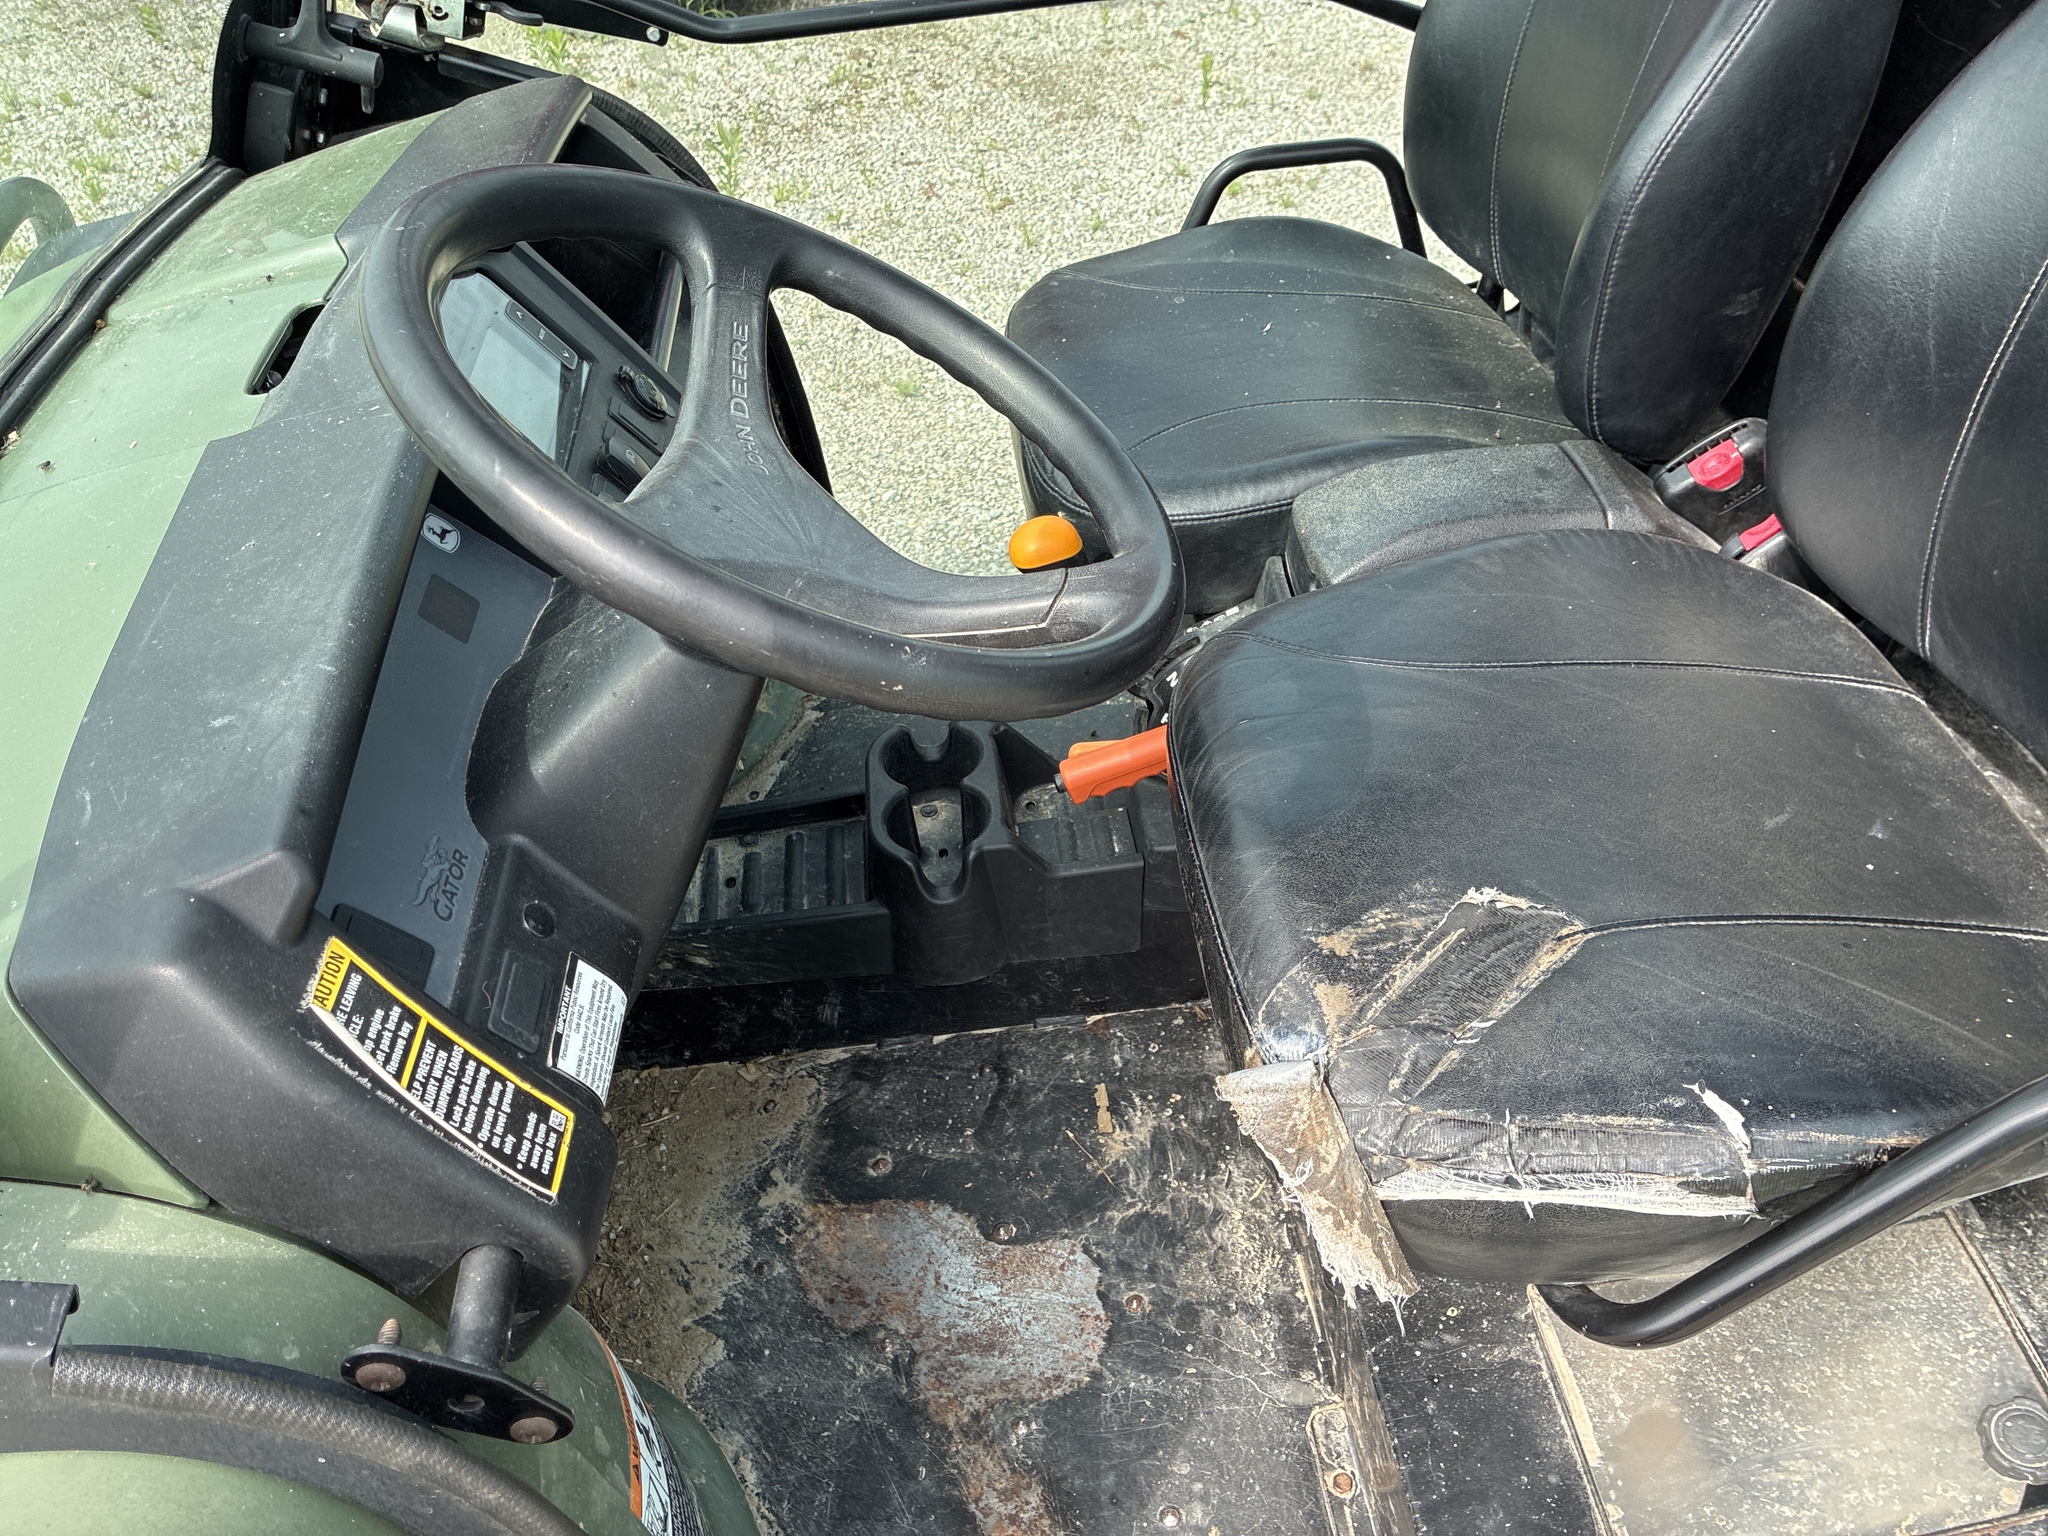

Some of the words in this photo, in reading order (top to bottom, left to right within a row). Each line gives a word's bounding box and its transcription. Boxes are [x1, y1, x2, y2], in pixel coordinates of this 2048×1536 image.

[730, 321, 749, 419] DEERE
[736, 424, 769, 476] JOHN
[1166, 671, 1178, 688] N
[433, 848, 470, 922] GATOR
[313, 950, 345, 1007] AUTION
[573, 971, 583, 995] Resources
[591, 979, 599, 990] May
[339, 972, 362, 1012] LEAVING
[570, 995, 578, 1010] Public
[587, 989, 597, 1015] Equipment
[385, 1005, 401, 1031] brake
[557, 985, 571, 1034] IMPORTANT
[566, 1010, 575, 1033] California
[366, 1008, 385, 1039] engine
[573, 1021, 581, 1034] Code
[585, 1049, 593, 1067] Sparks
[597, 987, 605, 1005] Around
[379, 1029, 393, 1052] park
[386, 1037, 406, 1074] Remove
[398, 1021, 413, 1038] key
[560, 1038, 569, 1061] Pursuant
[579, 1030, 589, 1055] Operation
[415, 1040, 437, 1082] PREVENT
[431, 1049, 448, 1078] WHEN
[461, 1059, 477, 1085] brake
[411, 1081, 423, 1100] ELP
[424, 1078, 440, 1111] NJURY
[435, 1075, 456, 1120] DUMPING
[447, 1045, 464, 1076] LOADS
[456, 1084, 469, 1106] park
[462, 1104, 478, 1134] before
[471, 1066, 491, 1104] dumping
[501, 1081, 516, 1113] ground
[449, 1104, 463, 1127] Lock
[477, 1106, 495, 1142] Operate
[487, 1081, 503, 1106] dump
[493, 1112, 507, 1135] level
[523, 1111, 538, 1139] hands
[535, 1123, 547, 1144] from
[492, 1136, 501, 1148] on
[502, 1133, 517, 1155] only
[518, 1139, 531, 1163] Keep
[546, 1132, 557, 1149] box
[530, 1145, 543, 1169] away
[541, 1149, 554, 1175] cargo
